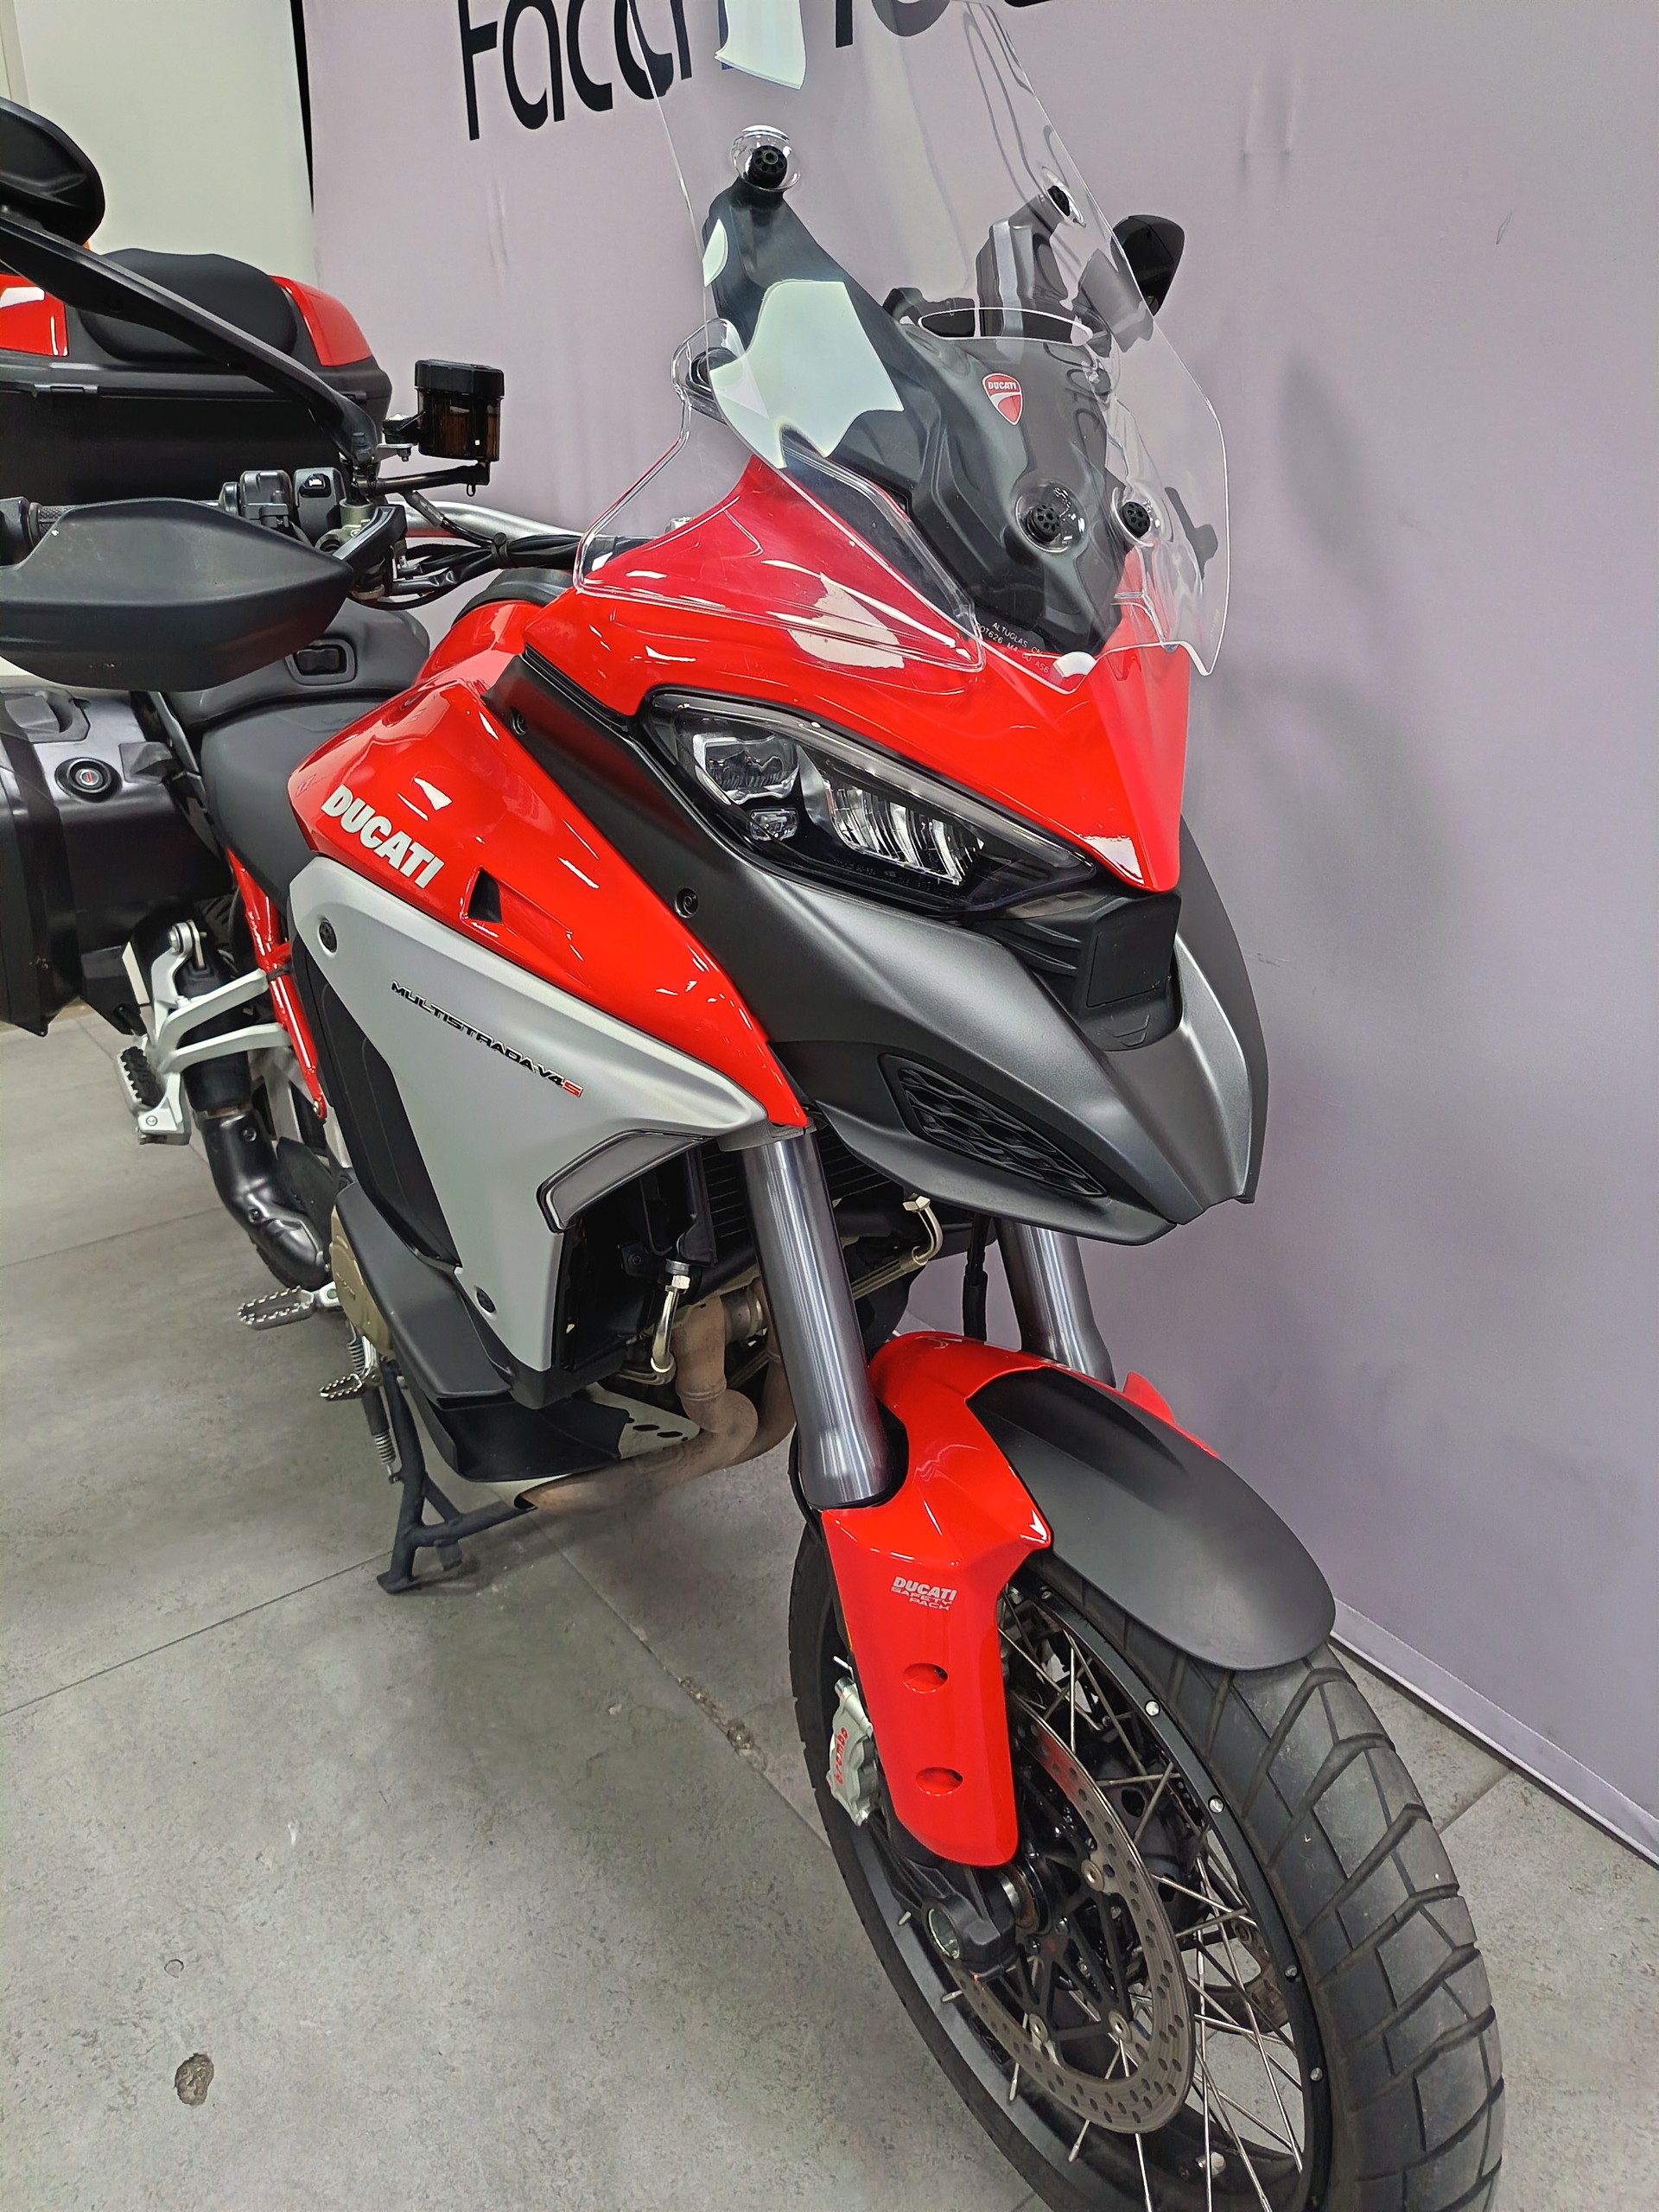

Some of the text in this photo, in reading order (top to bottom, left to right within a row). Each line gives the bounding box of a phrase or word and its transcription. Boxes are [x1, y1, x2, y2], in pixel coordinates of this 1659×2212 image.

[988, 381, 1016, 390] DUCATI
[321, 784, 445, 889] DUCATI
[891, 1586, 952, 1605] SAFETY
[893, 1576, 957, 1601] DUCATI
[909, 1597, 950, 1611] PACK
[834, 1727, 849, 1787] brembo
